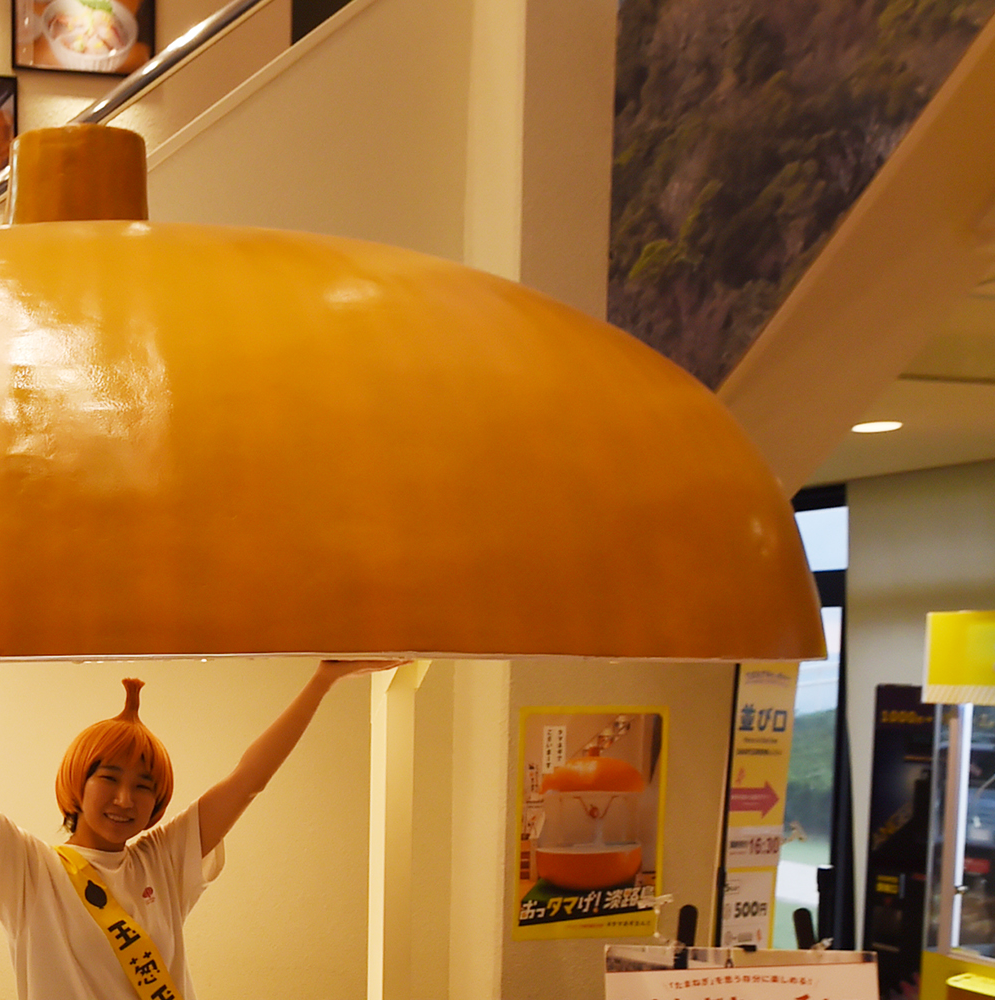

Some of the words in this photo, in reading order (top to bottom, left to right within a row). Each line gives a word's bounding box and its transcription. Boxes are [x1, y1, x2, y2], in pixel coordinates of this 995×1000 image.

[738, 703, 788, 732] 並び口
[749, 836, 780, 855] 16:30
[734, 901, 768, 919] 500円
